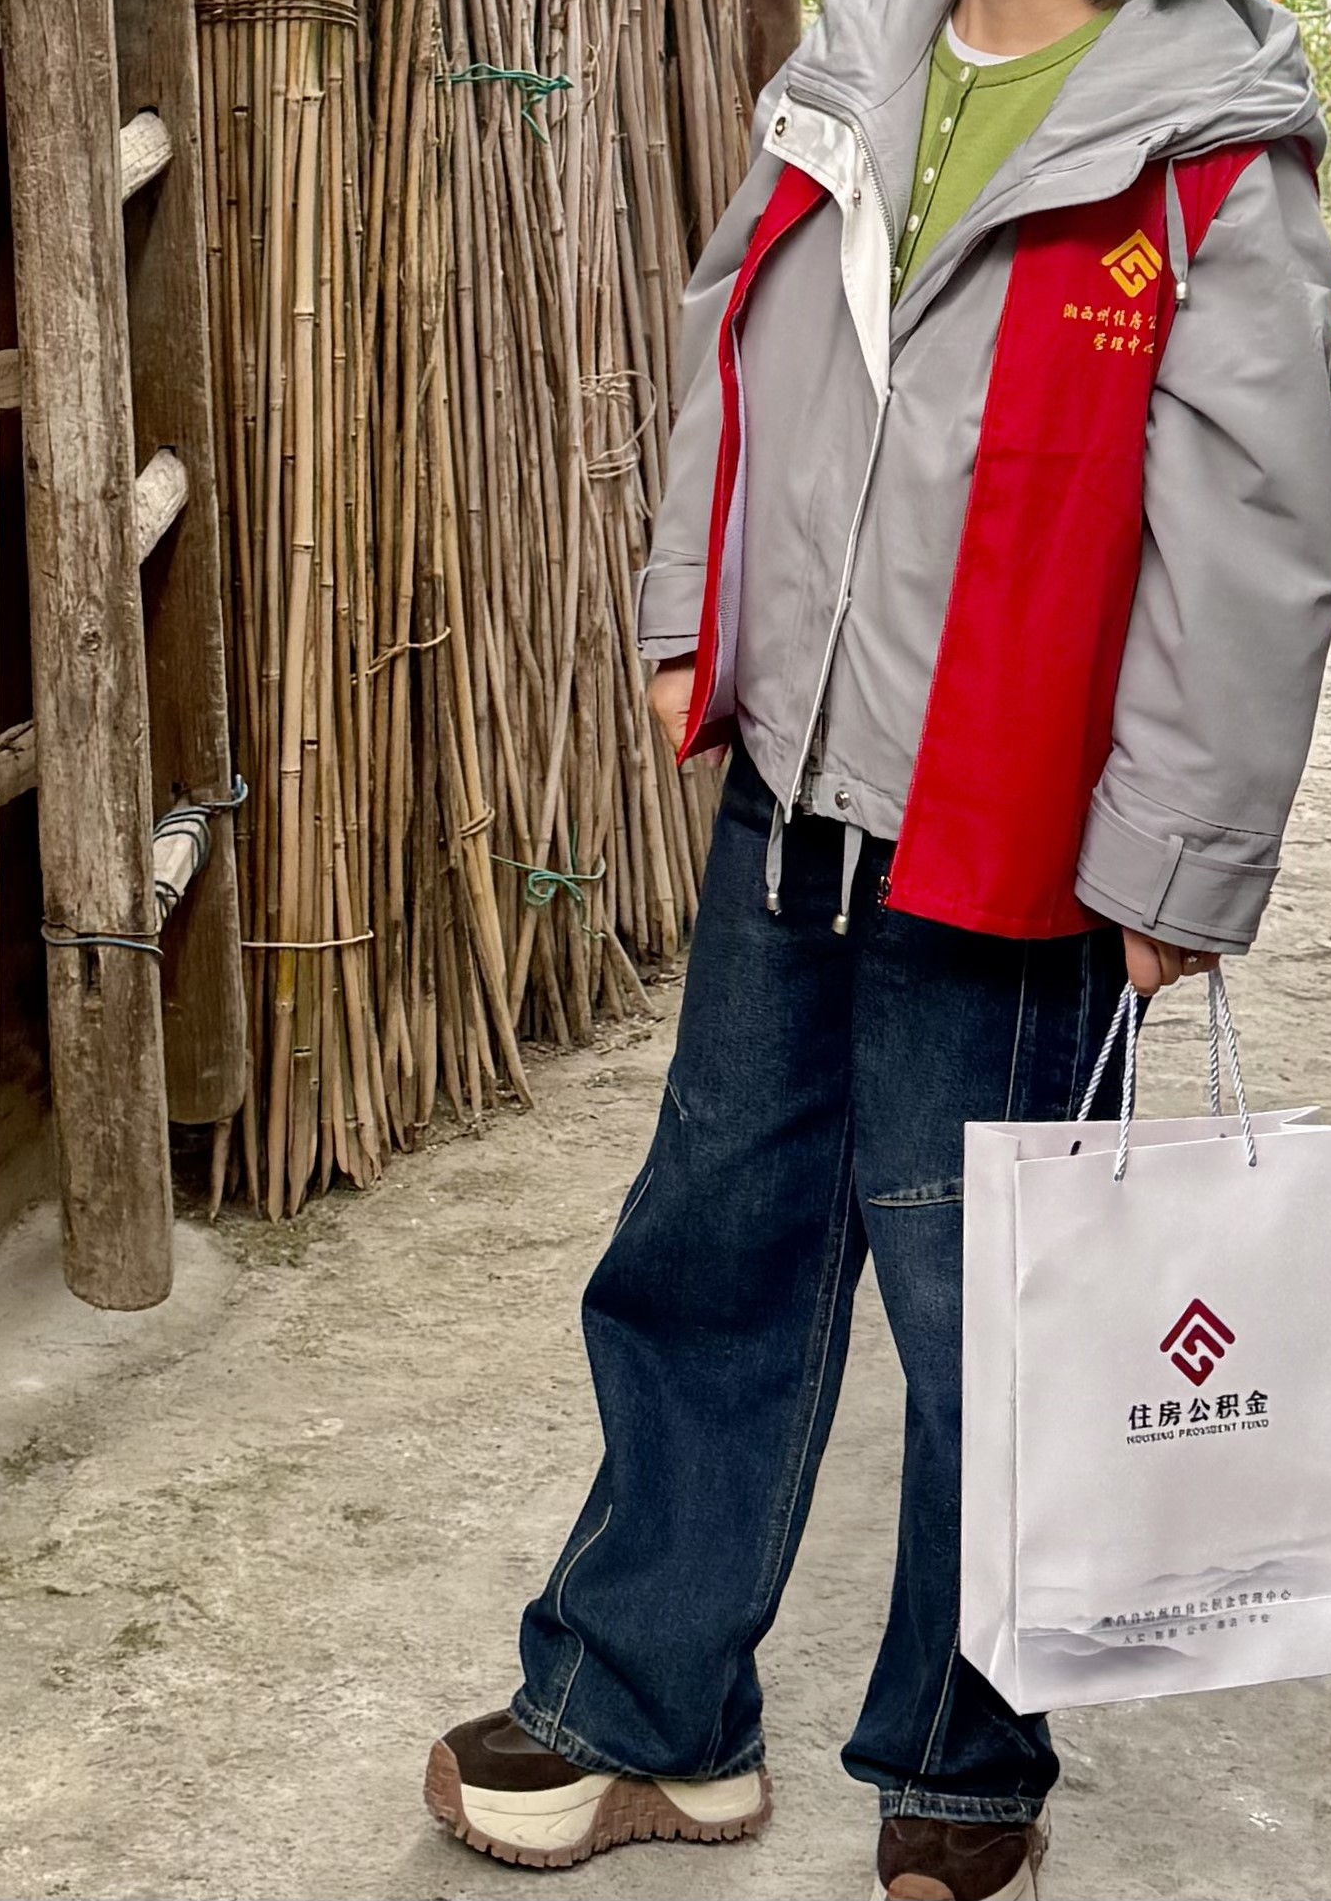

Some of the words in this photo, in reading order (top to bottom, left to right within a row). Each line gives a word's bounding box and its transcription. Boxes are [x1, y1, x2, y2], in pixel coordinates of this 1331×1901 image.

[1128, 1390, 1268, 1431] 住房公积金
[1126, 1430, 1174, 1445] HOUSING
[1179, 1423, 1237, 1438] PROVIDENT
[1241, 1419, 1269, 1431] FUND
